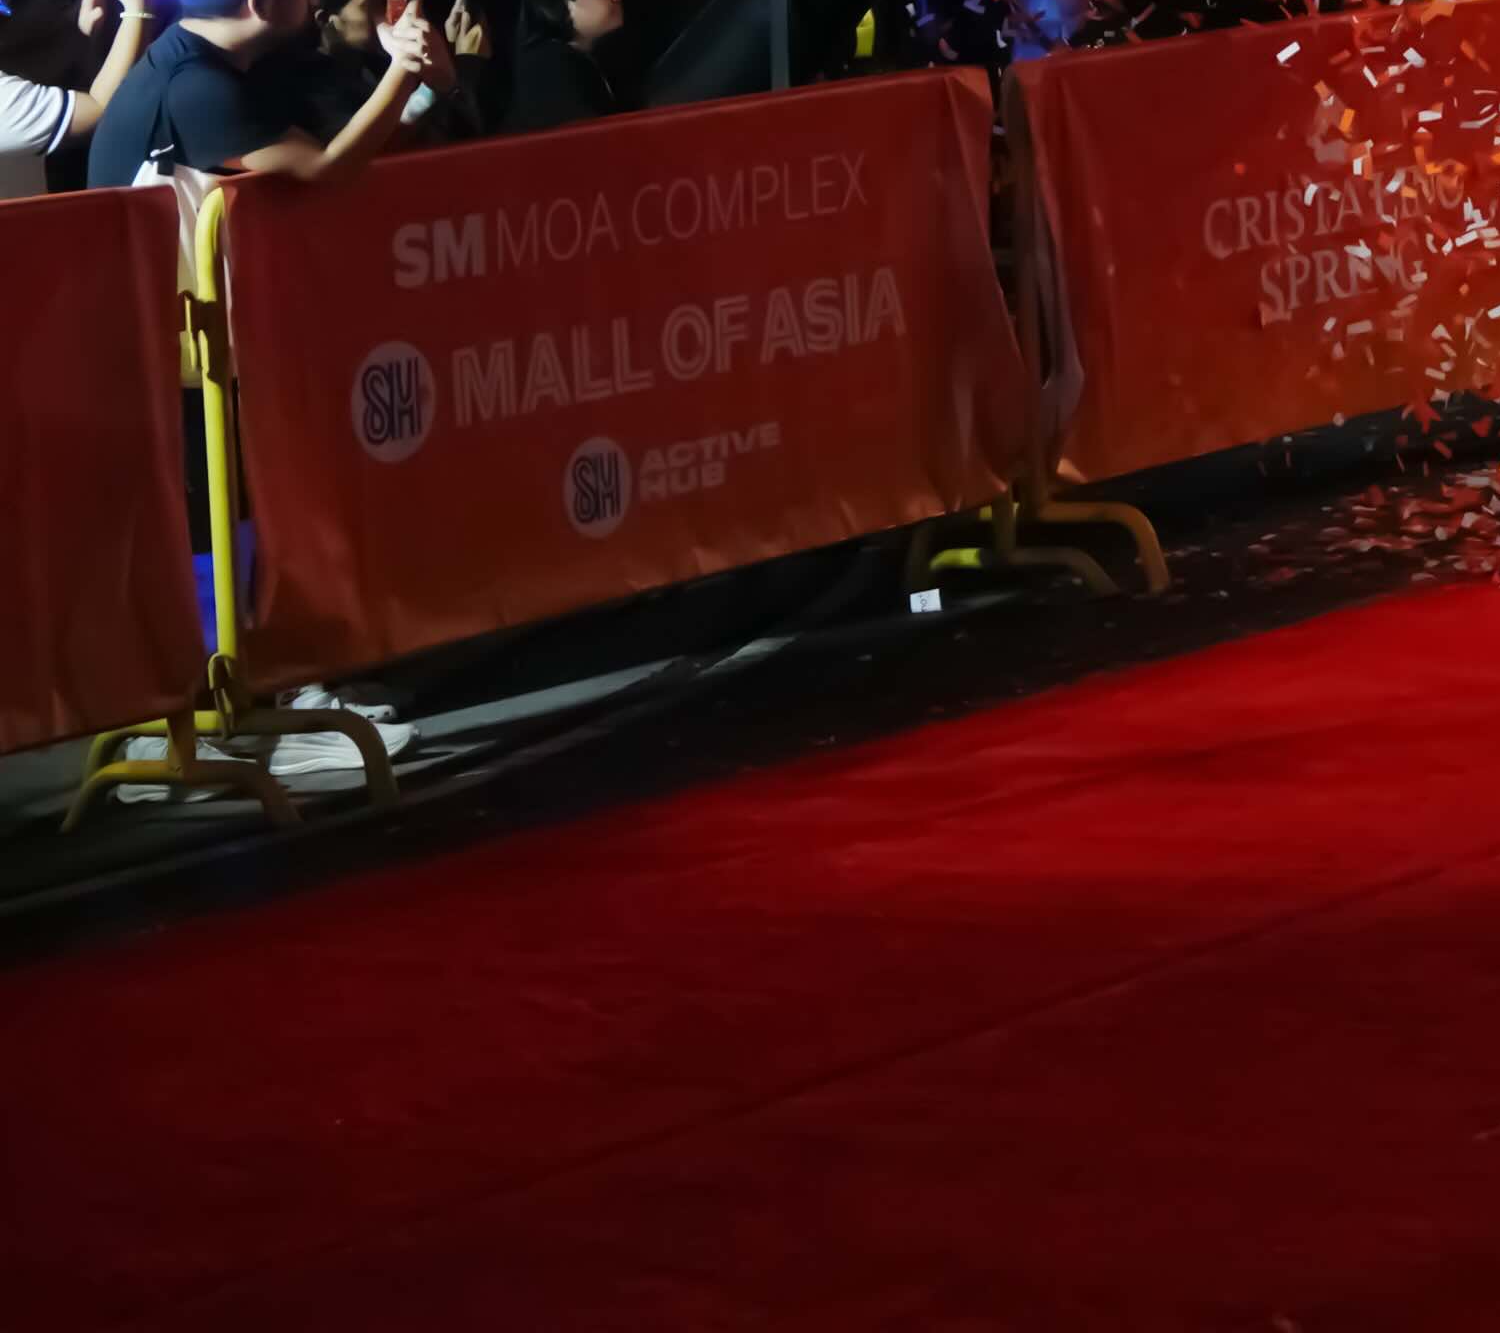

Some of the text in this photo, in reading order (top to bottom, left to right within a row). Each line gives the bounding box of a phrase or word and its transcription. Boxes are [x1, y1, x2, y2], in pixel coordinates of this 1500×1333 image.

[393, 150, 869, 288] SM MOA COMPLEX
[452, 266, 908, 427] MALL OF ASIA
[639, 422, 782, 472] ACTIVE
[639, 462, 726, 502] HUB
